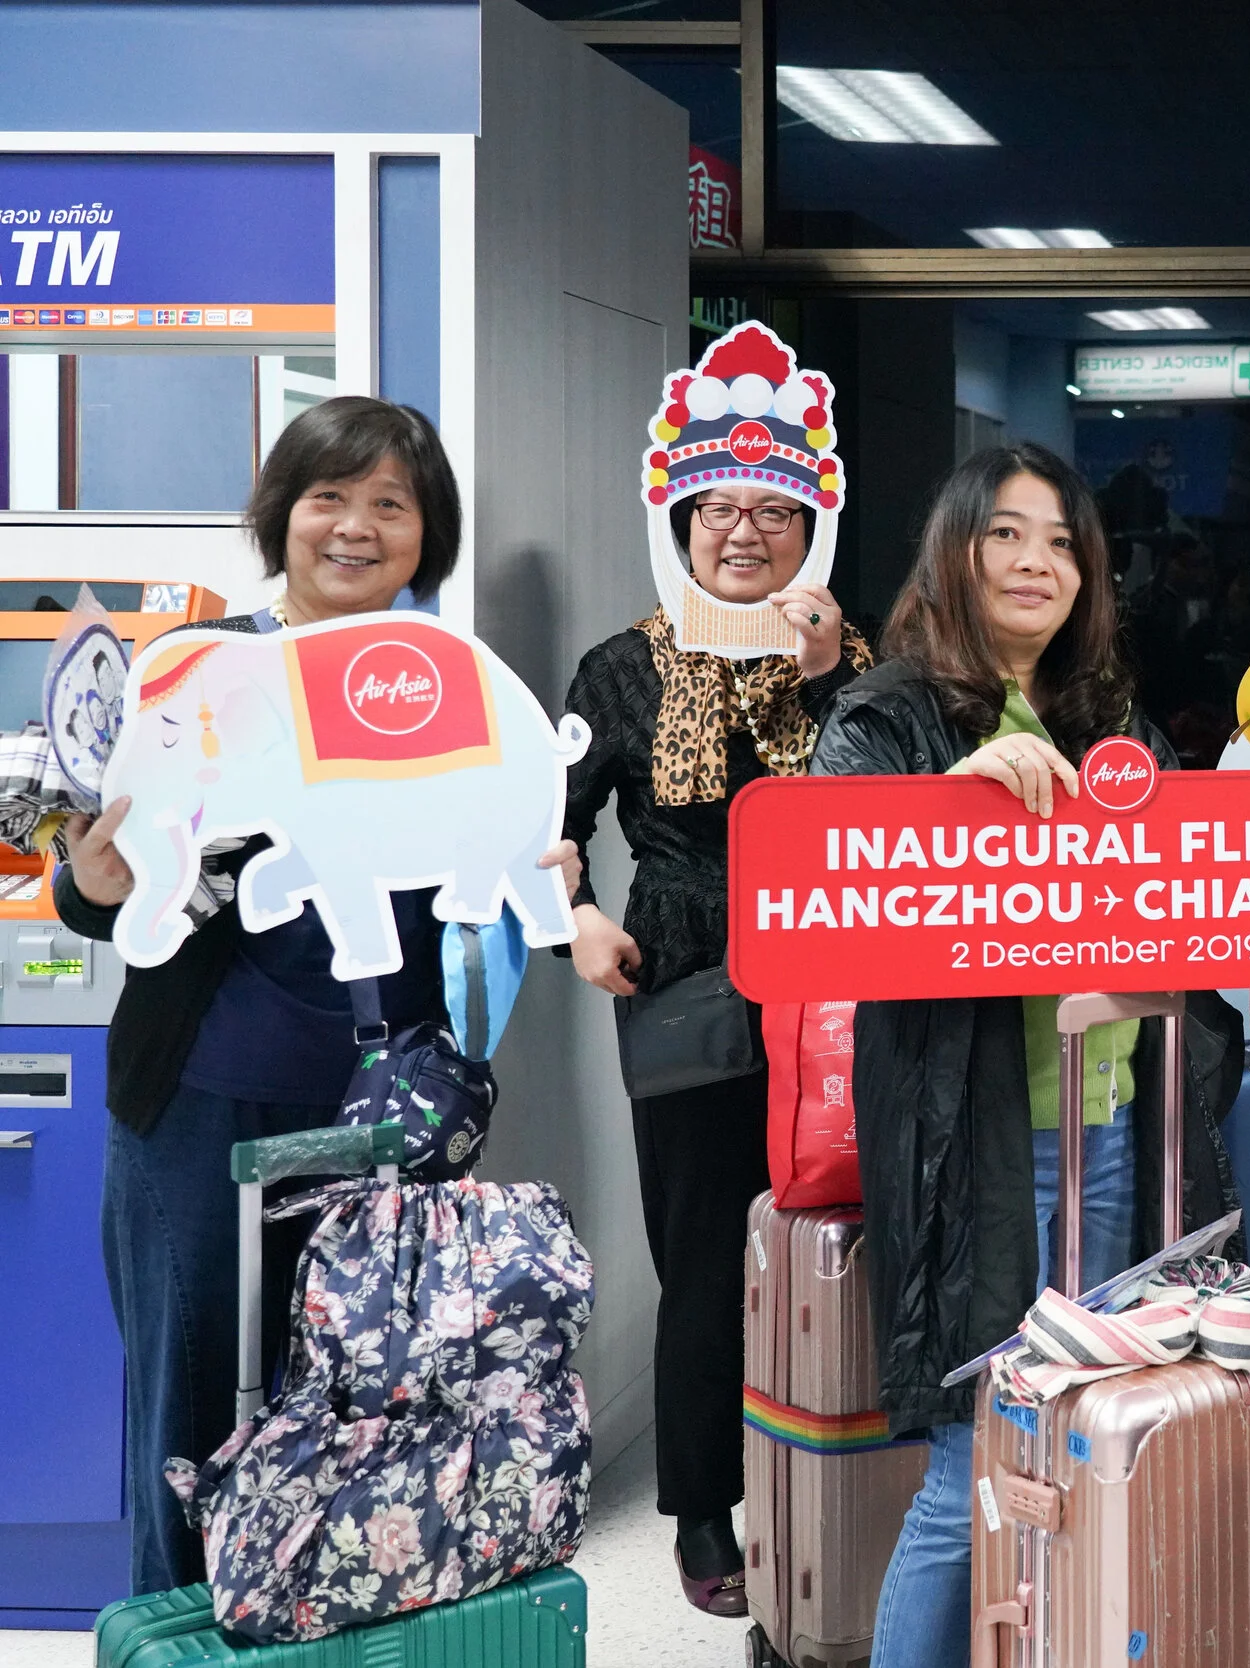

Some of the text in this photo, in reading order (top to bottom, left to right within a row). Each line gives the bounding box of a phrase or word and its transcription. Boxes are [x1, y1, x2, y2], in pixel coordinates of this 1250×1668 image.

[48, 203, 114, 224] เอทีเอ็ม
[0, 231, 121, 286] TM
[826, 822, 1162, 871] INAUGURAL
[756, 882, 1083, 930] HANGZHOU
[951, 942, 971, 969] 2
[982, 935, 1175, 968] December
